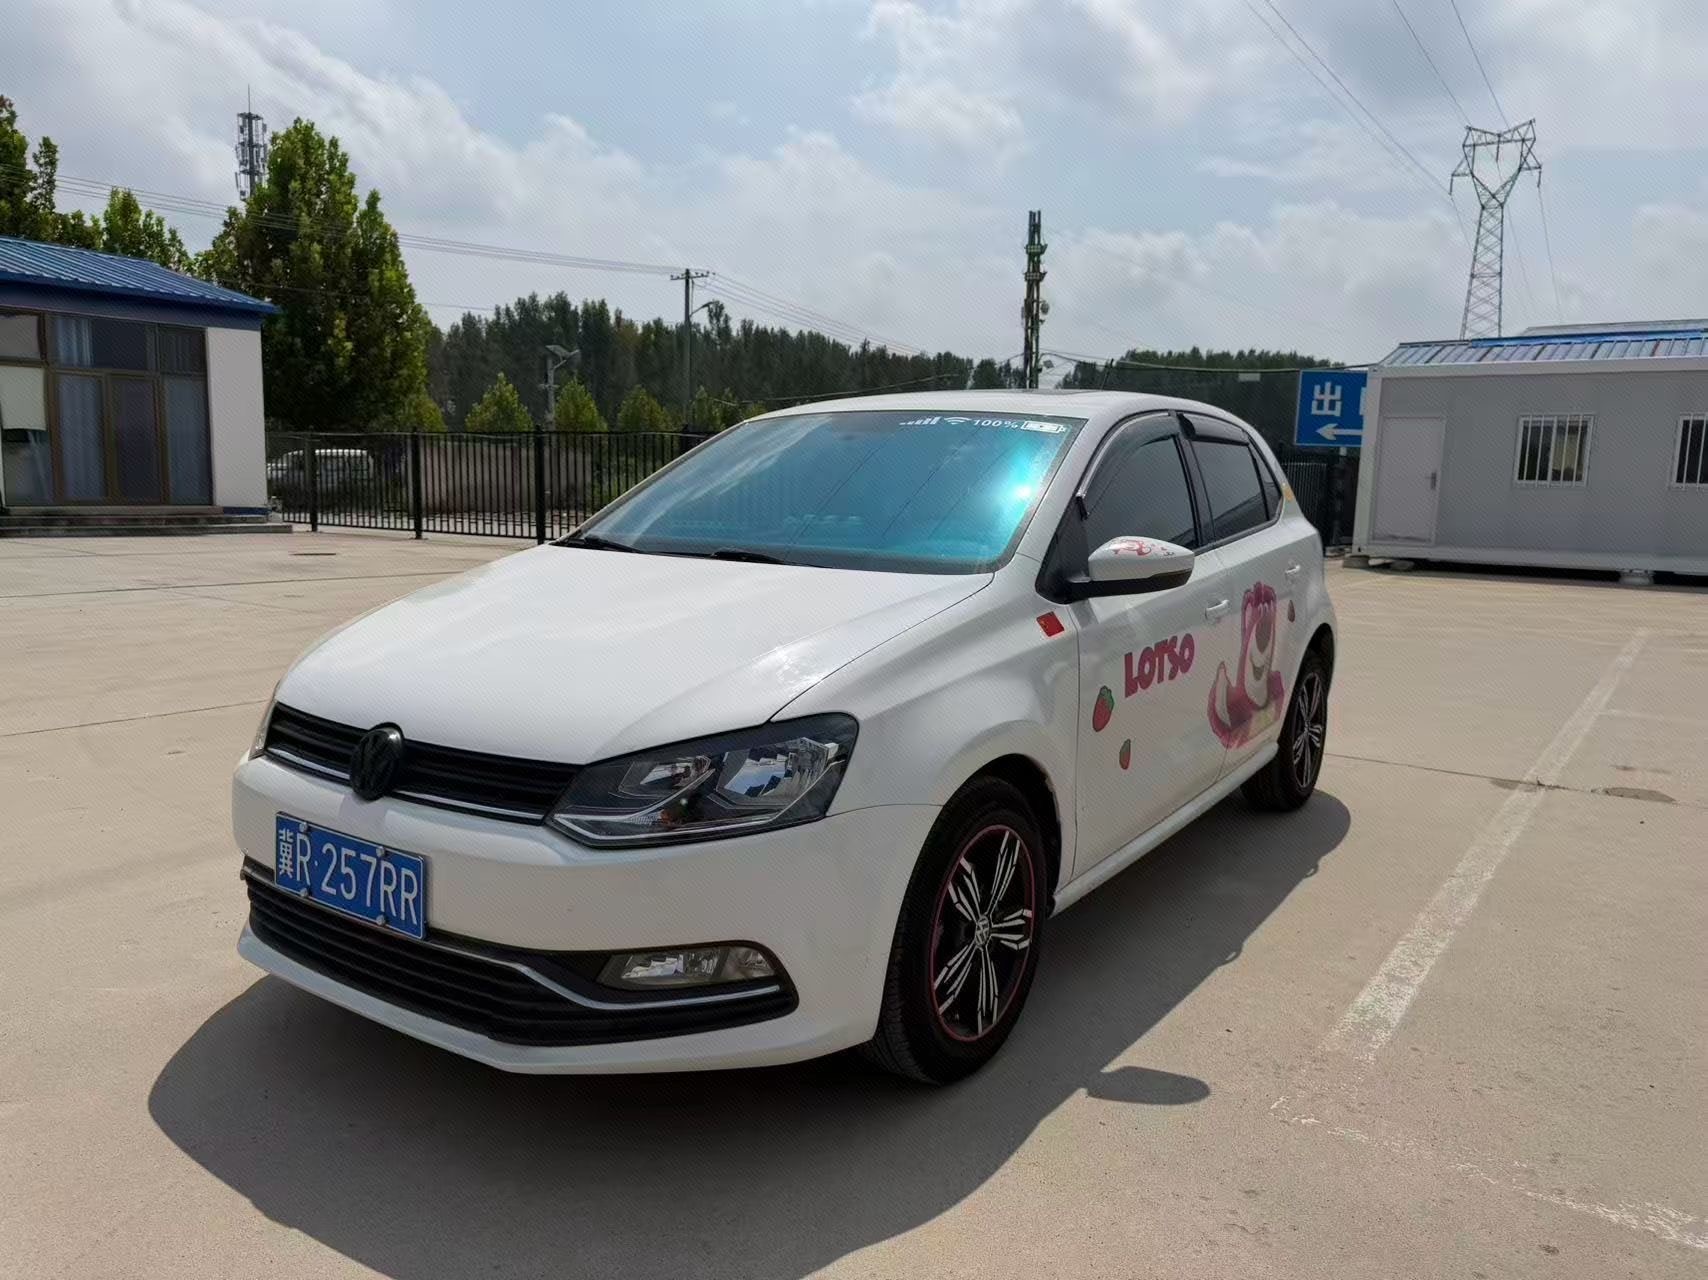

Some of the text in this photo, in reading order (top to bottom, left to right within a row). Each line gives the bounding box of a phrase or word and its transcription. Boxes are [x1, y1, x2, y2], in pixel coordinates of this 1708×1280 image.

[1311, 382, 1366, 416] 出
[973, 419, 1019, 429] 100%
[1124, 633, 1195, 698] LOTSO
